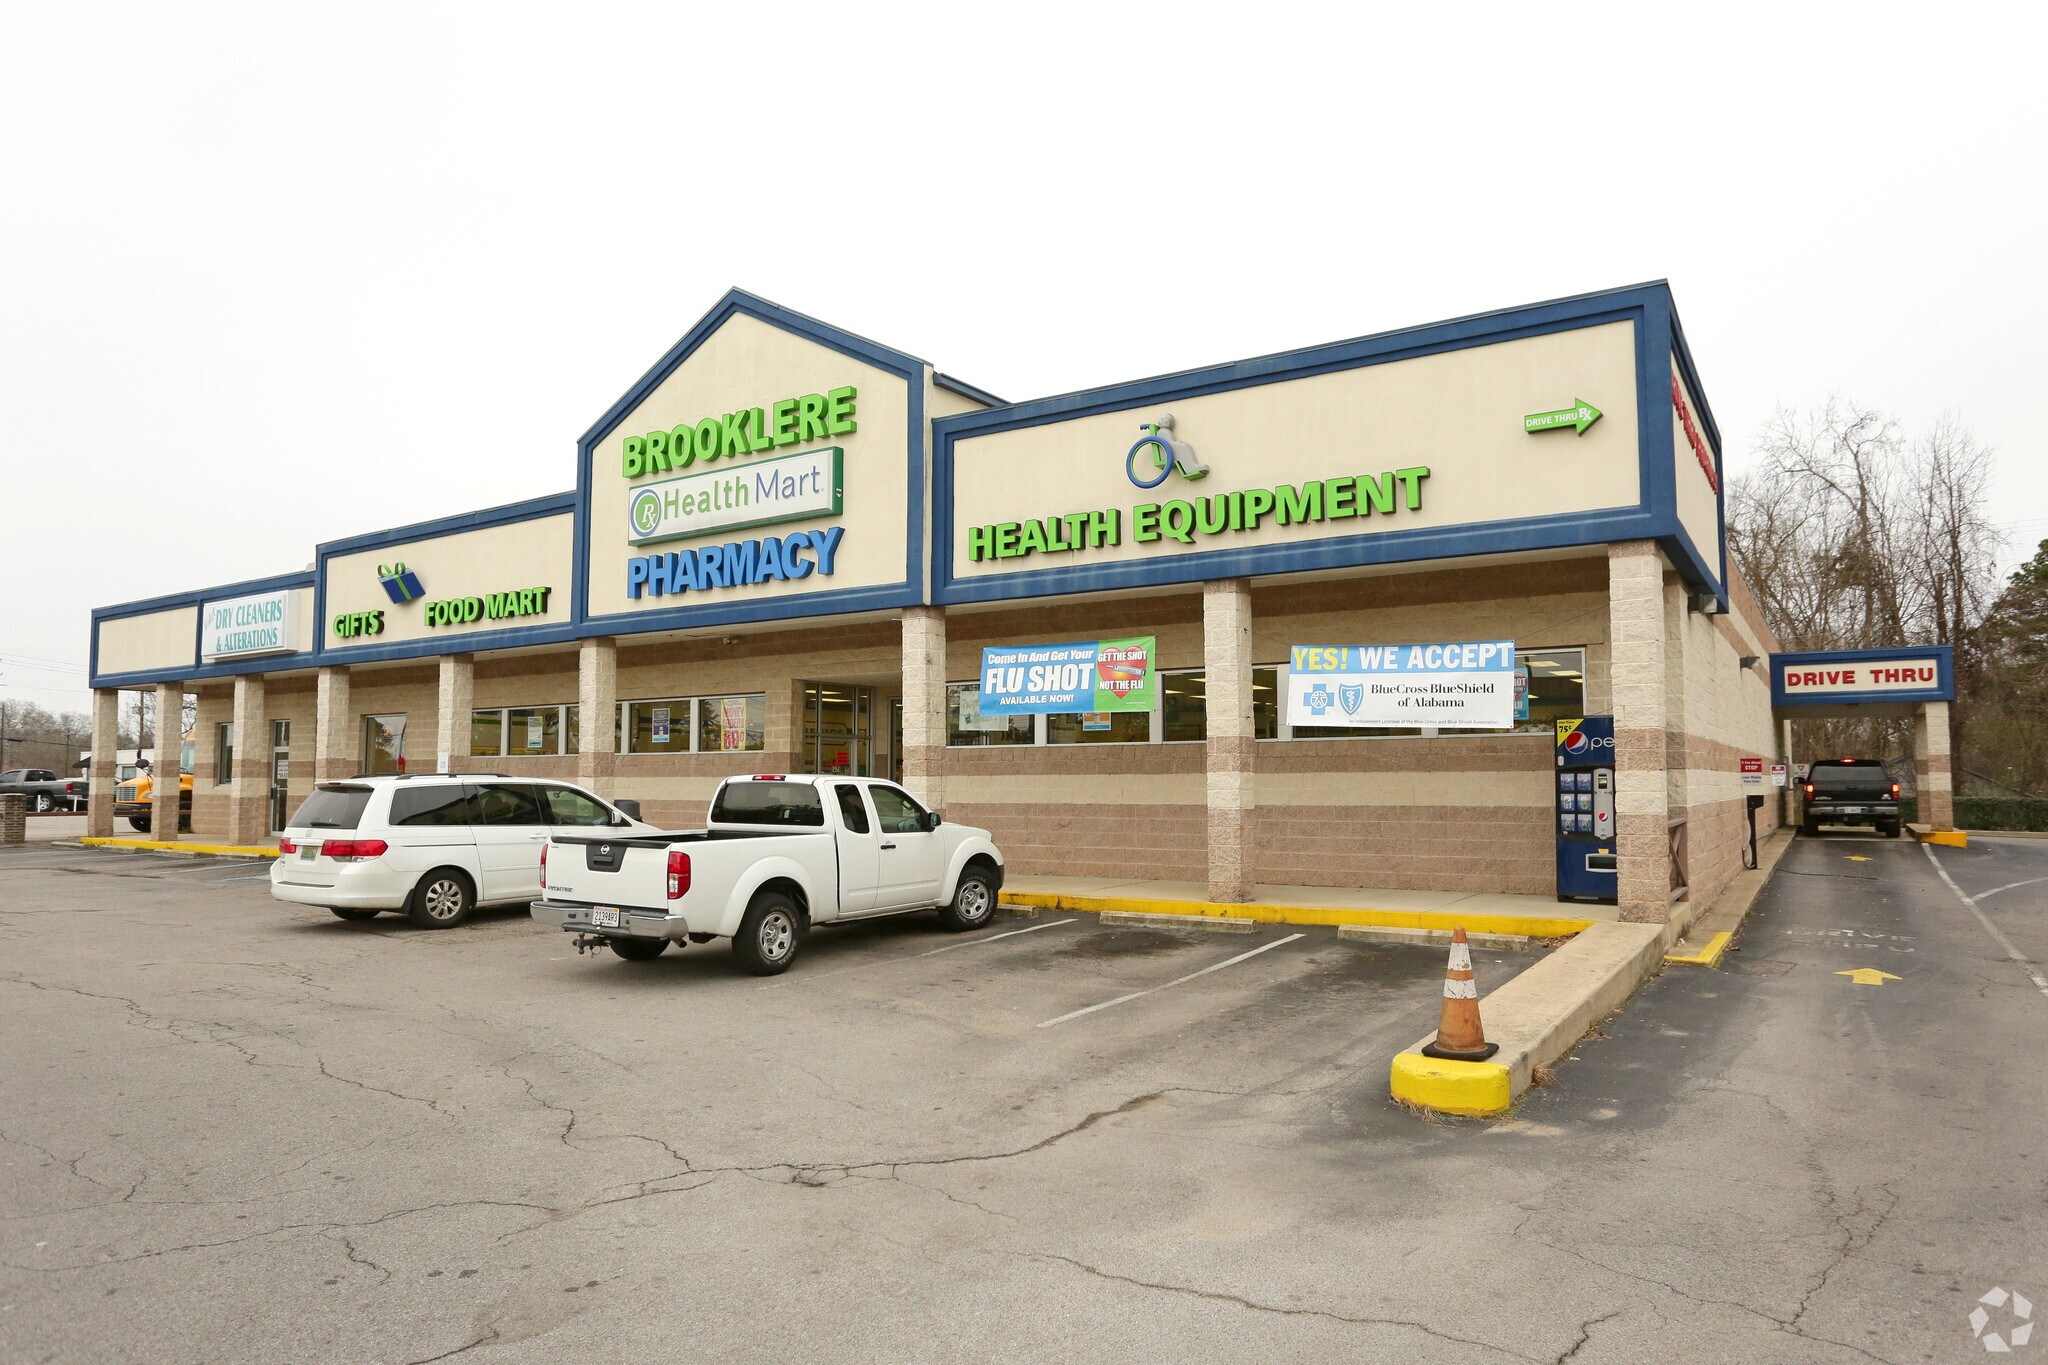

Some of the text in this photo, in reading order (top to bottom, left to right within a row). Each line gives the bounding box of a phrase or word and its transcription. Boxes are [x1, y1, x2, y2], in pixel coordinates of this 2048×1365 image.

[622, 386, 857, 478] BROOKLERE
[1526, 416, 1552, 427] DRIVE
[1555, 412, 1577, 422] THRU
[663, 476, 749, 519] Health
[755, 465, 820, 503] Mart
[968, 466, 1430, 561] HEALTH EQUIPMENT
[627, 527, 845, 599] PHARMACY
[215, 607, 234, 630] DRY
[236, 599, 282, 627] CLEANERS
[425, 586, 552, 627] FOOD MART
[333, 609, 384, 638] GIFTS
[216, 627, 278, 652] & ALTERATIONS
[987, 649, 1095, 665] Come In And Get Your
[1097, 650, 1148, 662] GET THE SHOT
[1292, 642, 1513, 671] YES! WE ACCEPT
[985, 662, 1095, 694] FLU SHOT
[1099, 679, 1144, 690] NOT THE FLU
[1371, 682, 1494, 694] BlueCross BlueShield
[1787, 667, 1934, 686] DRIVE THRU
[999, 693, 1075, 705] AVAILABLE NOW!
[1398, 697, 1465, 708] of Alabama
[1591, 737, 1614, 750] pe
